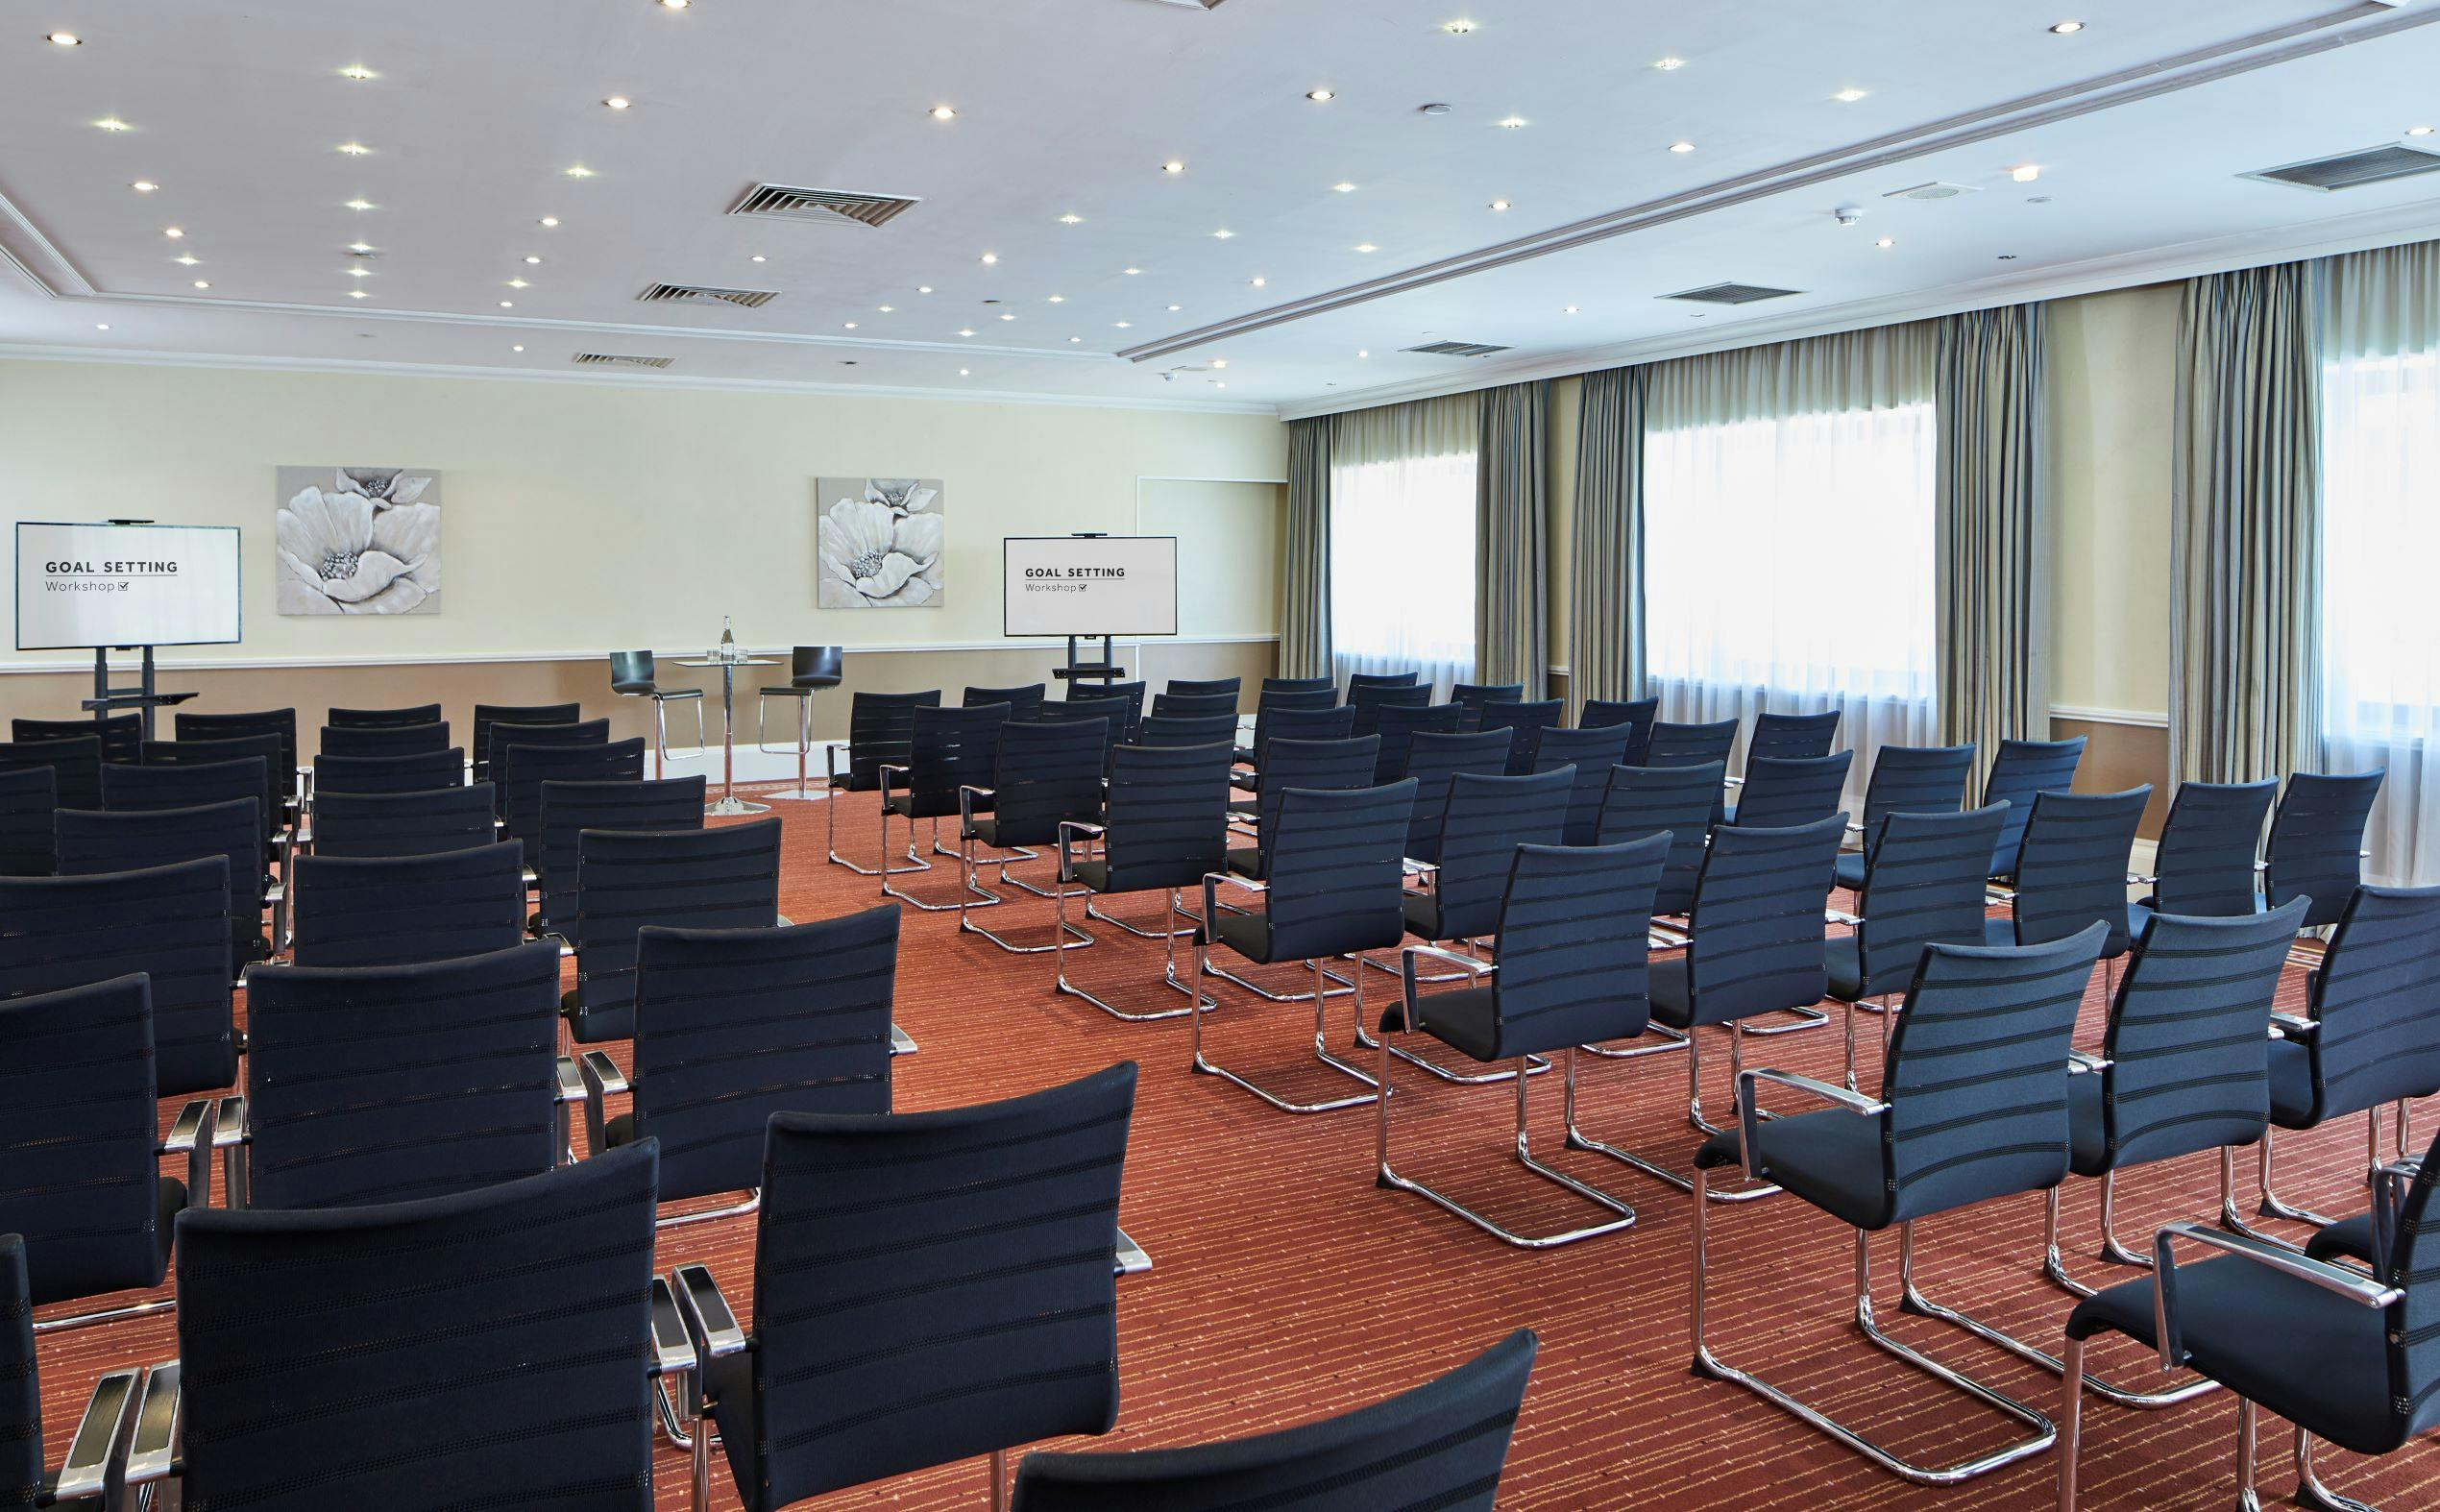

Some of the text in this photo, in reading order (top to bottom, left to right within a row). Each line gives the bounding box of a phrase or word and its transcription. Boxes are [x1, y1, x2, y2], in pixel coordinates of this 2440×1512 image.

[46, 561, 178, 573] GOAL SETTING
[1025, 568, 1125, 577] GOAL SETTING
[46, 581, 115, 594] Workshop
[1025, 583, 1077, 593] Workshop
